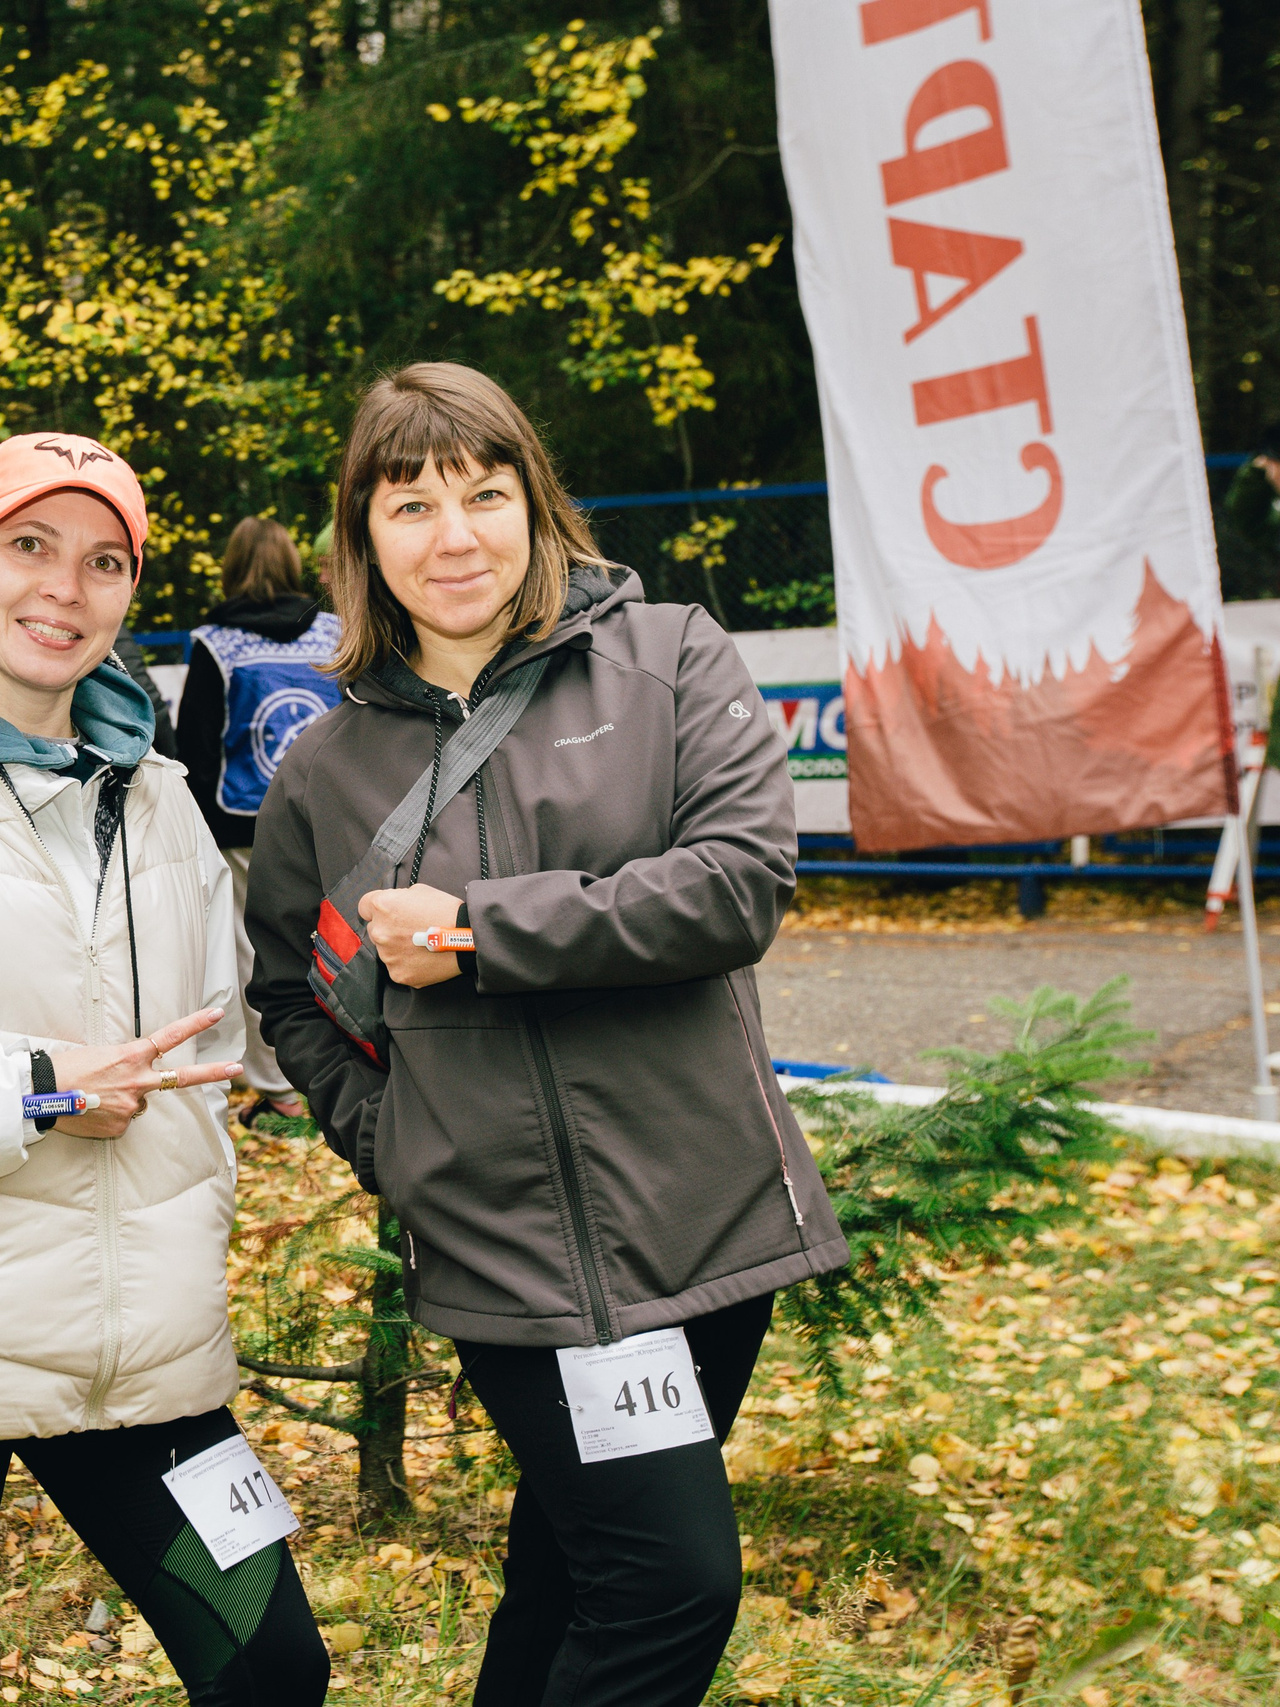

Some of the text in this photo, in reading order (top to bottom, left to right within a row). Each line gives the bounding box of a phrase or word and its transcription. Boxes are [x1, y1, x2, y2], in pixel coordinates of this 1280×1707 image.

[554, 722, 615, 748] CRAGHOPPERS
[614, 1371, 681, 1417] 416
[230, 1470, 272, 1515] 417
